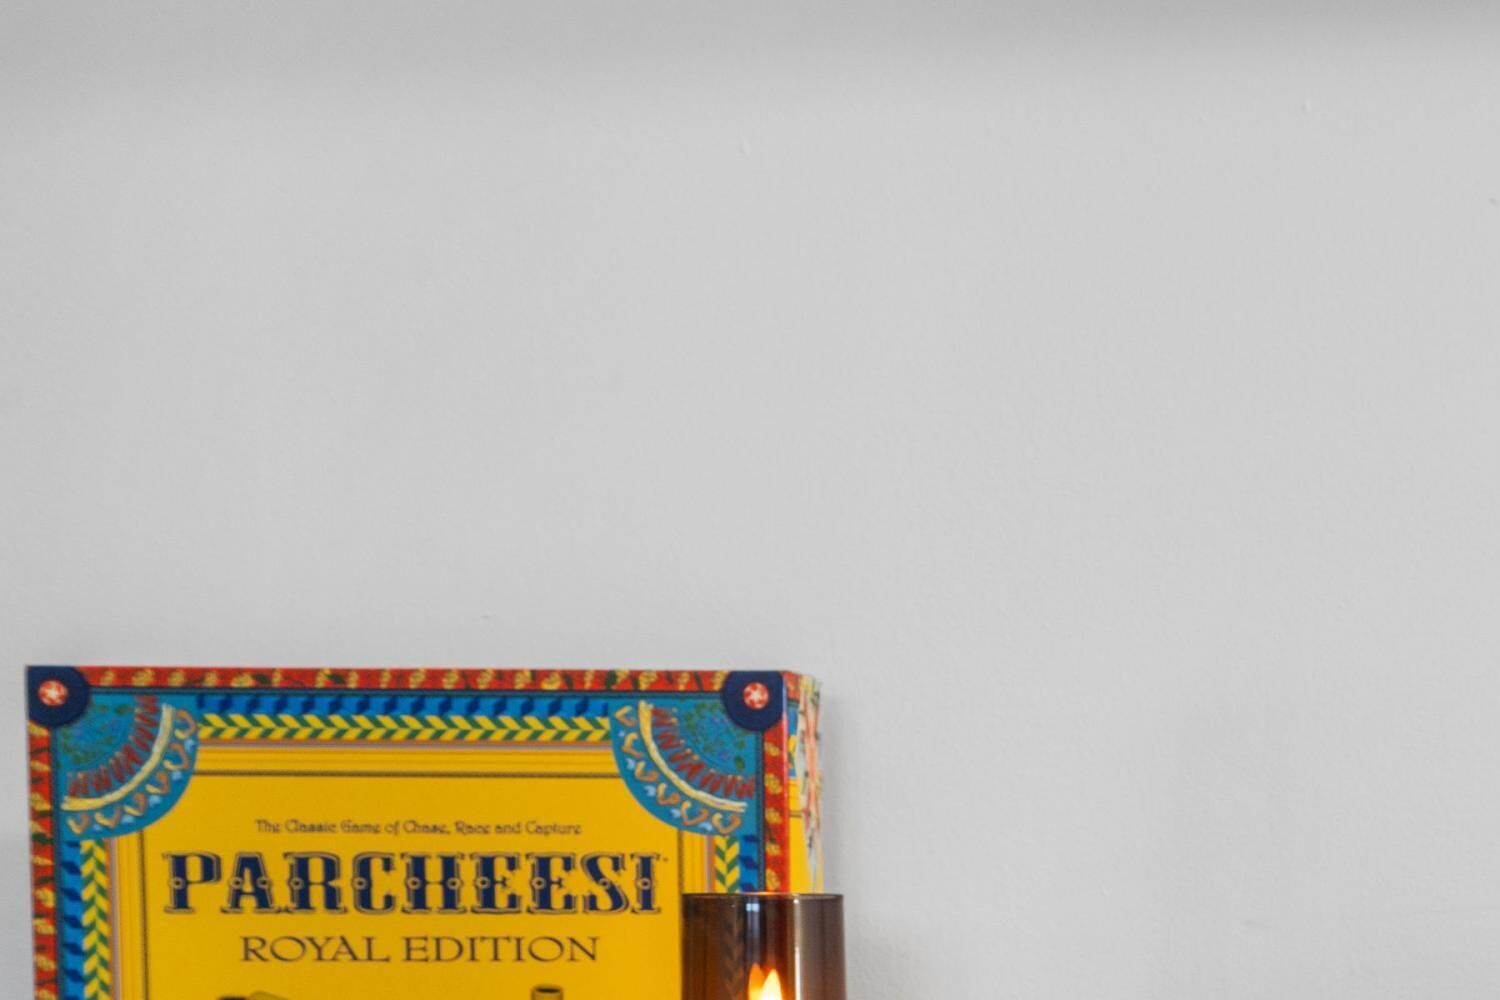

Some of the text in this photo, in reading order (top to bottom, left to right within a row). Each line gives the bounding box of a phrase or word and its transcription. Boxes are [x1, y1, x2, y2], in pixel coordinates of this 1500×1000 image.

[256, 819, 582, 837] The Classic Game of Chase, Race and Capture
[162, 851, 663, 915] PARCHEESI
[240, 936, 600, 963] ROYAL EDITION
